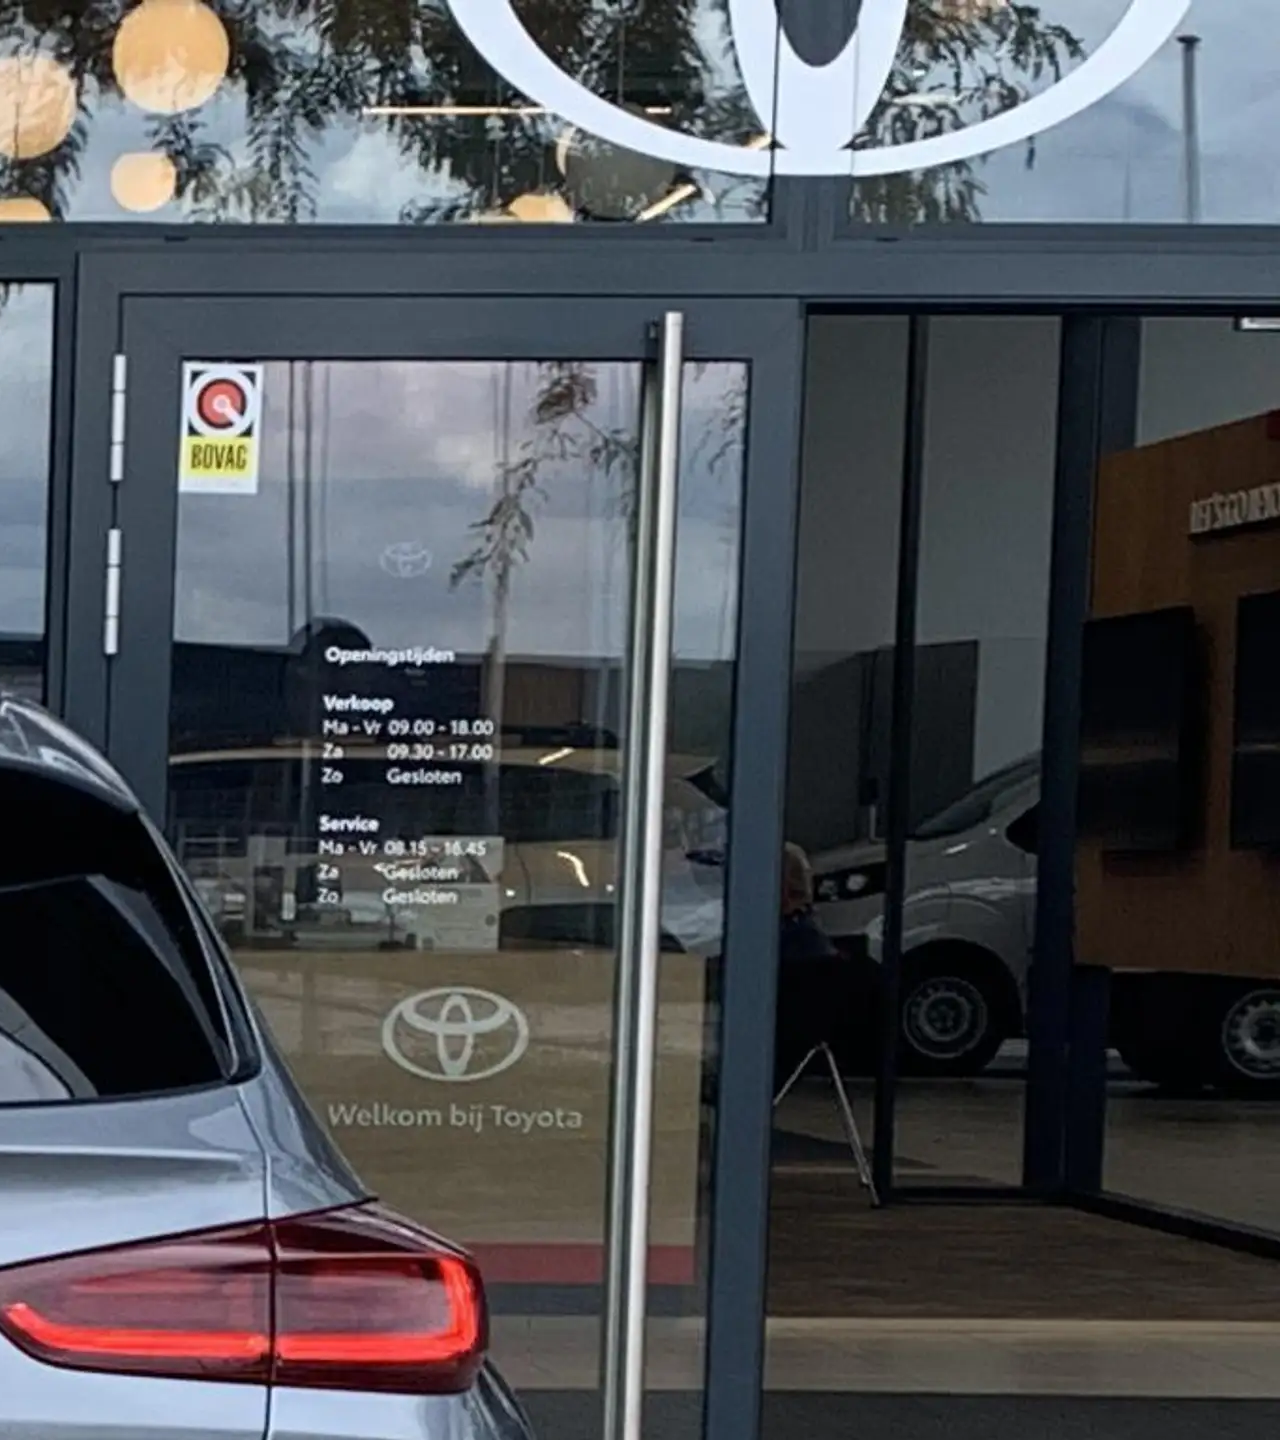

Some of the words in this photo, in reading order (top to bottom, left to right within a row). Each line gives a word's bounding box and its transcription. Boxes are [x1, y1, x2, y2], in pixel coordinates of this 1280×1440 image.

[190, 444, 248, 471] BOVAG
[324, 646, 456, 666] Openingstijden
[322, 695, 395, 714] Verkoop
[322, 720, 349, 735] Ma
[362, 720, 382, 735] Vr
[387, 719, 435, 735] 09.00
[450, 719, 494, 735] 18.00
[322, 743, 344, 759] Za
[386, 743, 435, 760] 09.30
[449, 744, 493, 760] 17.00
[321, 767, 344, 784] Zo
[386, 767, 463, 784] Gesloten
[318, 814, 380, 833] Service
[318, 840, 344, 855] Ma
[359, 840, 378, 855] Vr
[317, 863, 340, 881] Za
[383, 864, 459, 881] Gesloten
[317, 887, 340, 904] Zo
[382, 887, 459, 905] Gesloten
[327, 1102, 442, 1127] Welkom
[449, 1102, 483, 1132] bij
[491, 1104, 583, 1134] Toyota
